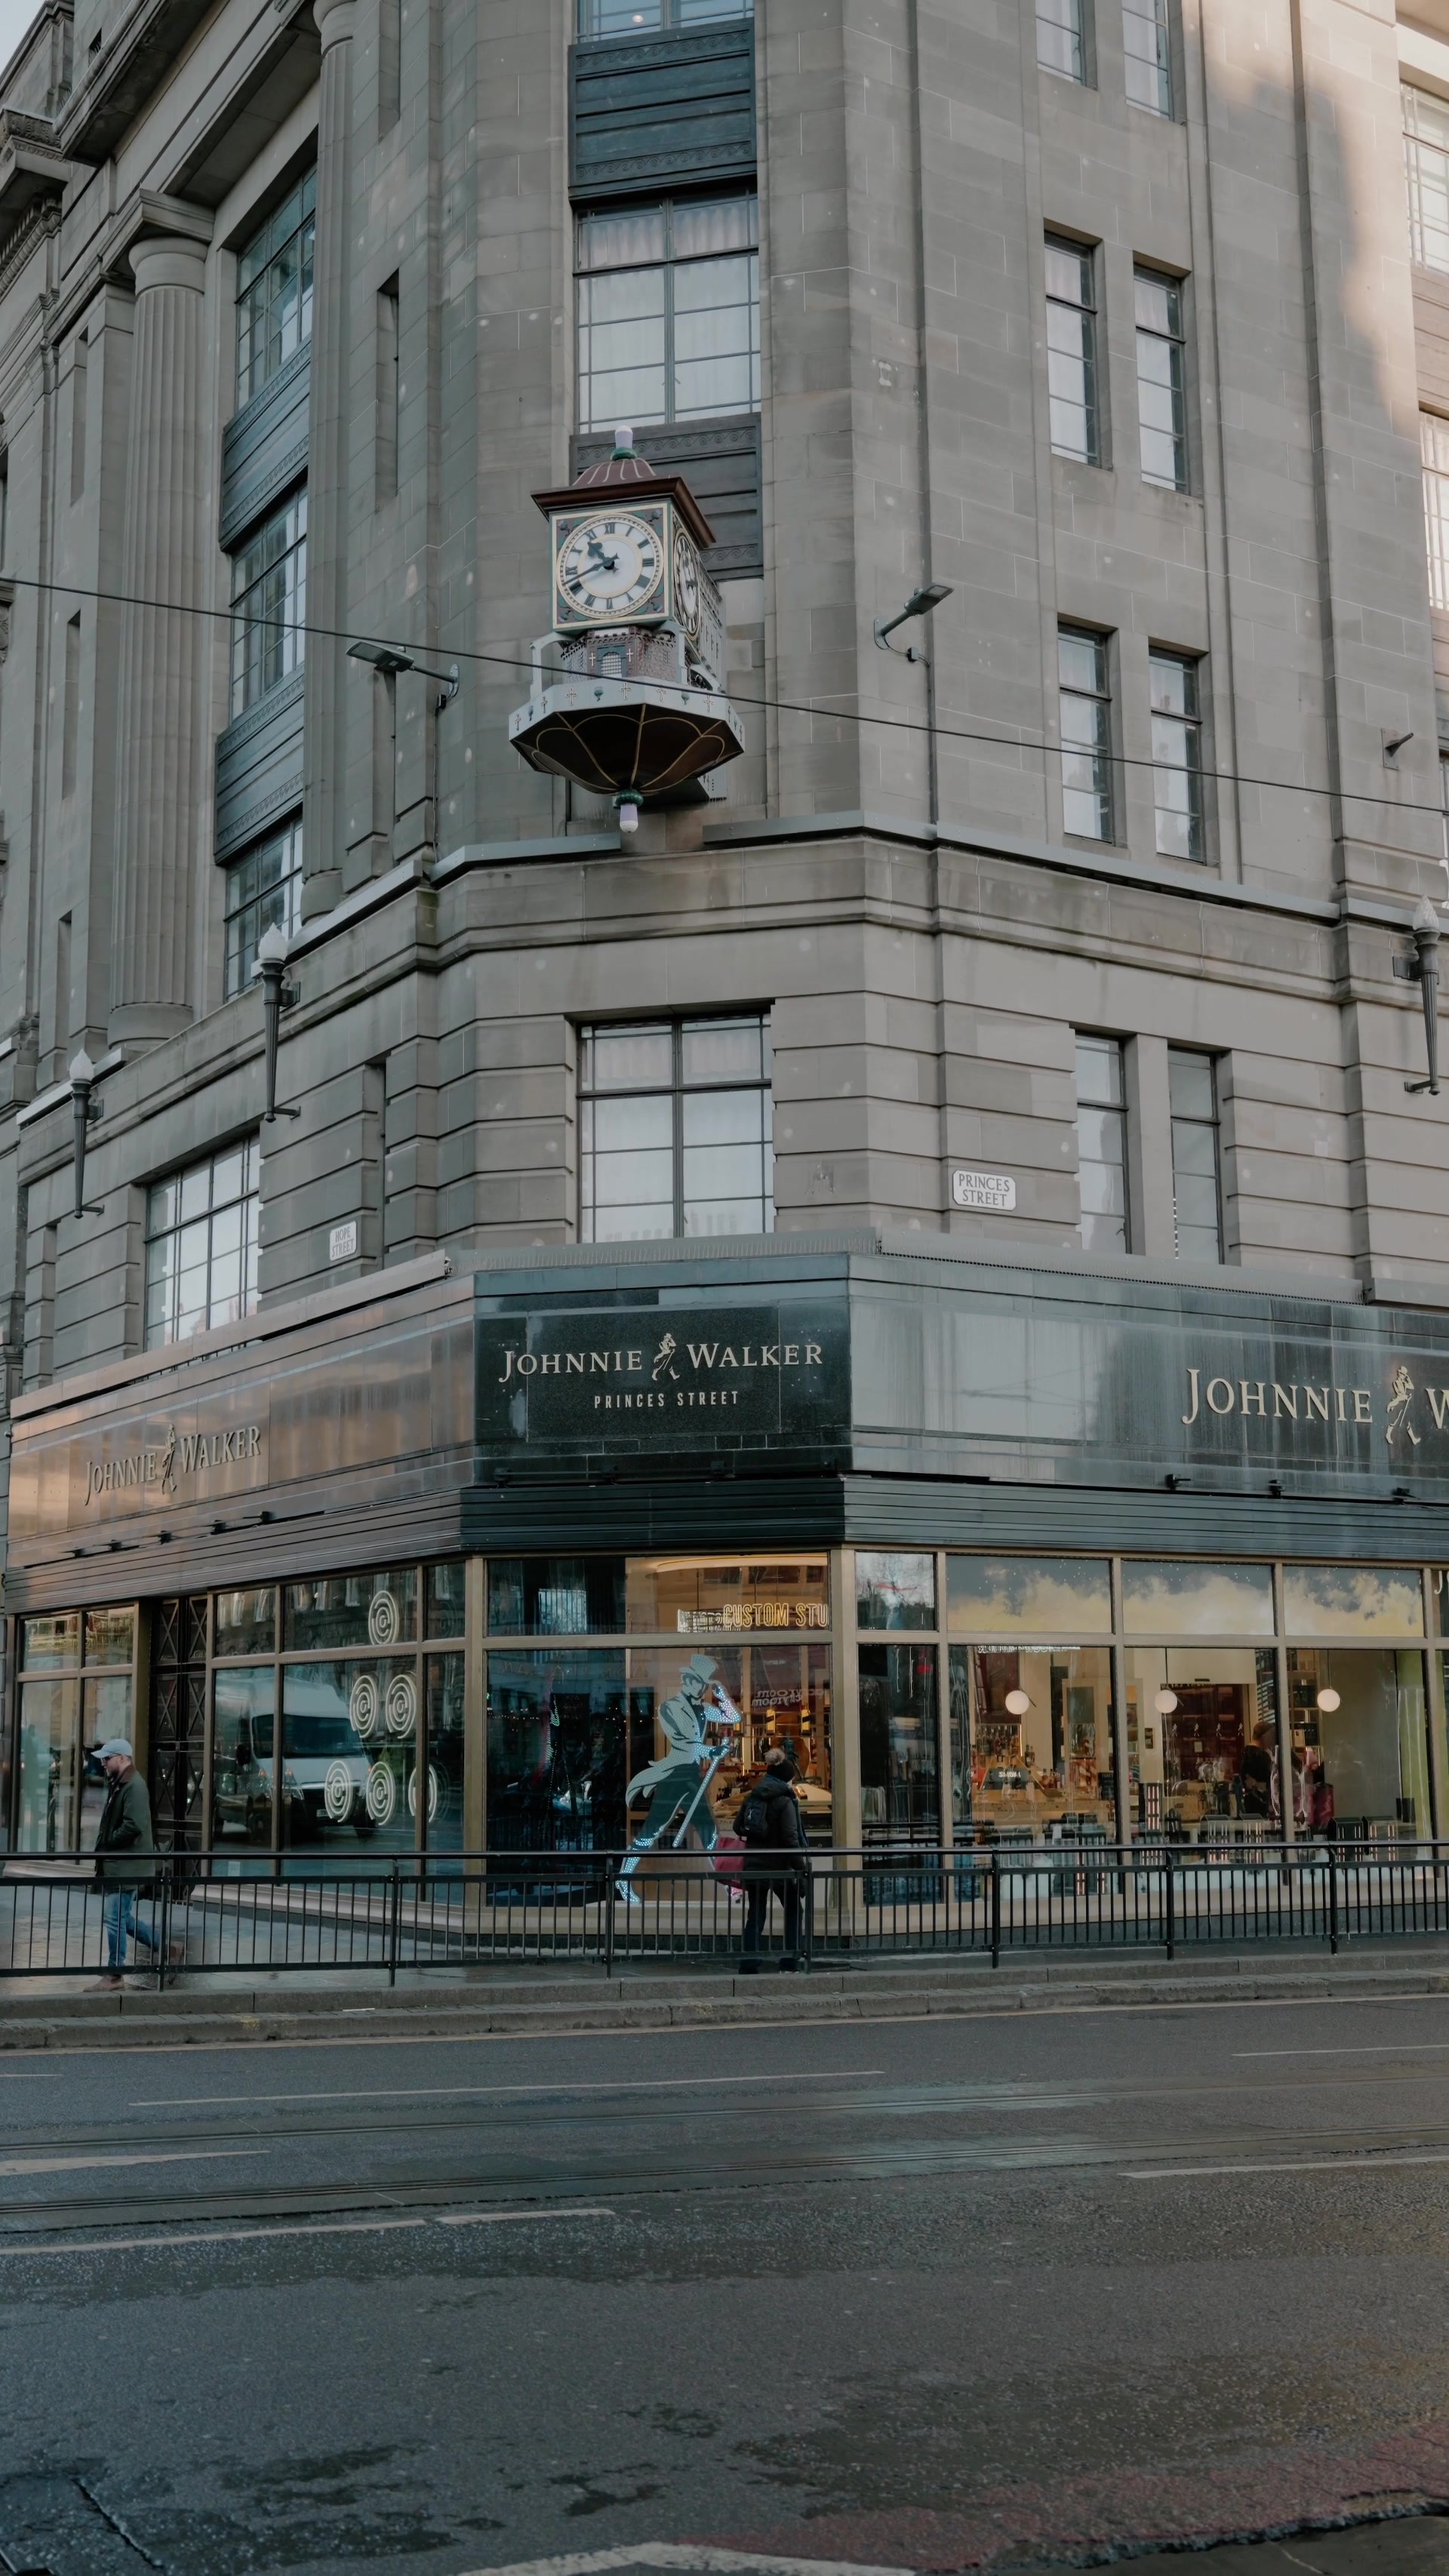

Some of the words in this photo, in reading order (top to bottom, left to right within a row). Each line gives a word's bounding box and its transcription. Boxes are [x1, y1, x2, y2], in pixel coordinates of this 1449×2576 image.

[958, 1173, 1010, 1192] PRINCES
[962, 1189, 1007, 1207] STREET
[335, 1226, 351, 1243] HOPE
[332, 1238, 354, 1258] STREET
[499, 1350, 643, 1383] JOHNNIE
[686, 1342, 823, 1369] WALKER
[594, 1392, 666, 1409] PRINCES
[677, 1391, 739, 1407] STREET
[1182, 1369, 1374, 1425] JOHNNIE
[83, 1452, 157, 1506] JOHNNIE
[180, 1425, 261, 1474] WALKER
[723, 1603, 789, 1627] CUSTOM
